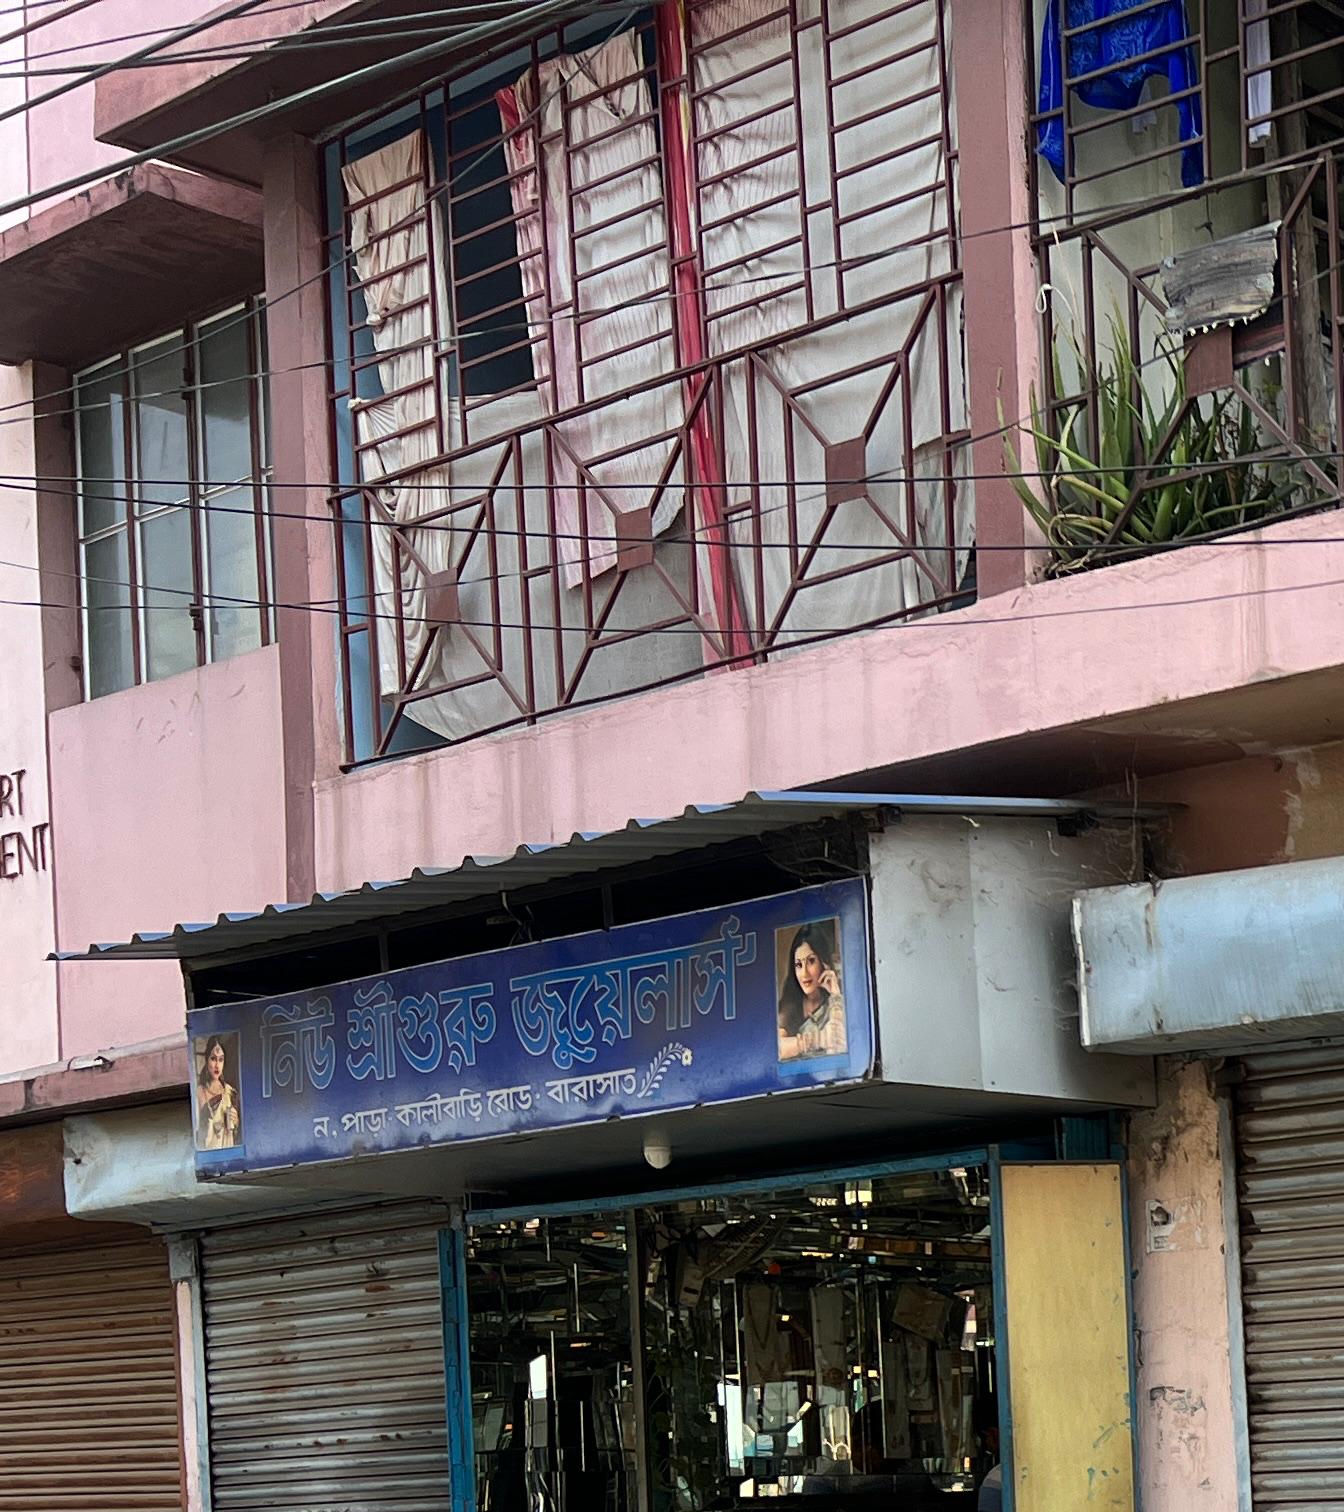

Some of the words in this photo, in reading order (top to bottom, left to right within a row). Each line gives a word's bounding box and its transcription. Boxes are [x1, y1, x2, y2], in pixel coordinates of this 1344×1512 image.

[260, 996, 336, 1099] নিউ
[346, 980, 497, 1081] শ্রীগুরু
[545, 1068, 637, 1105] বারাসাত
